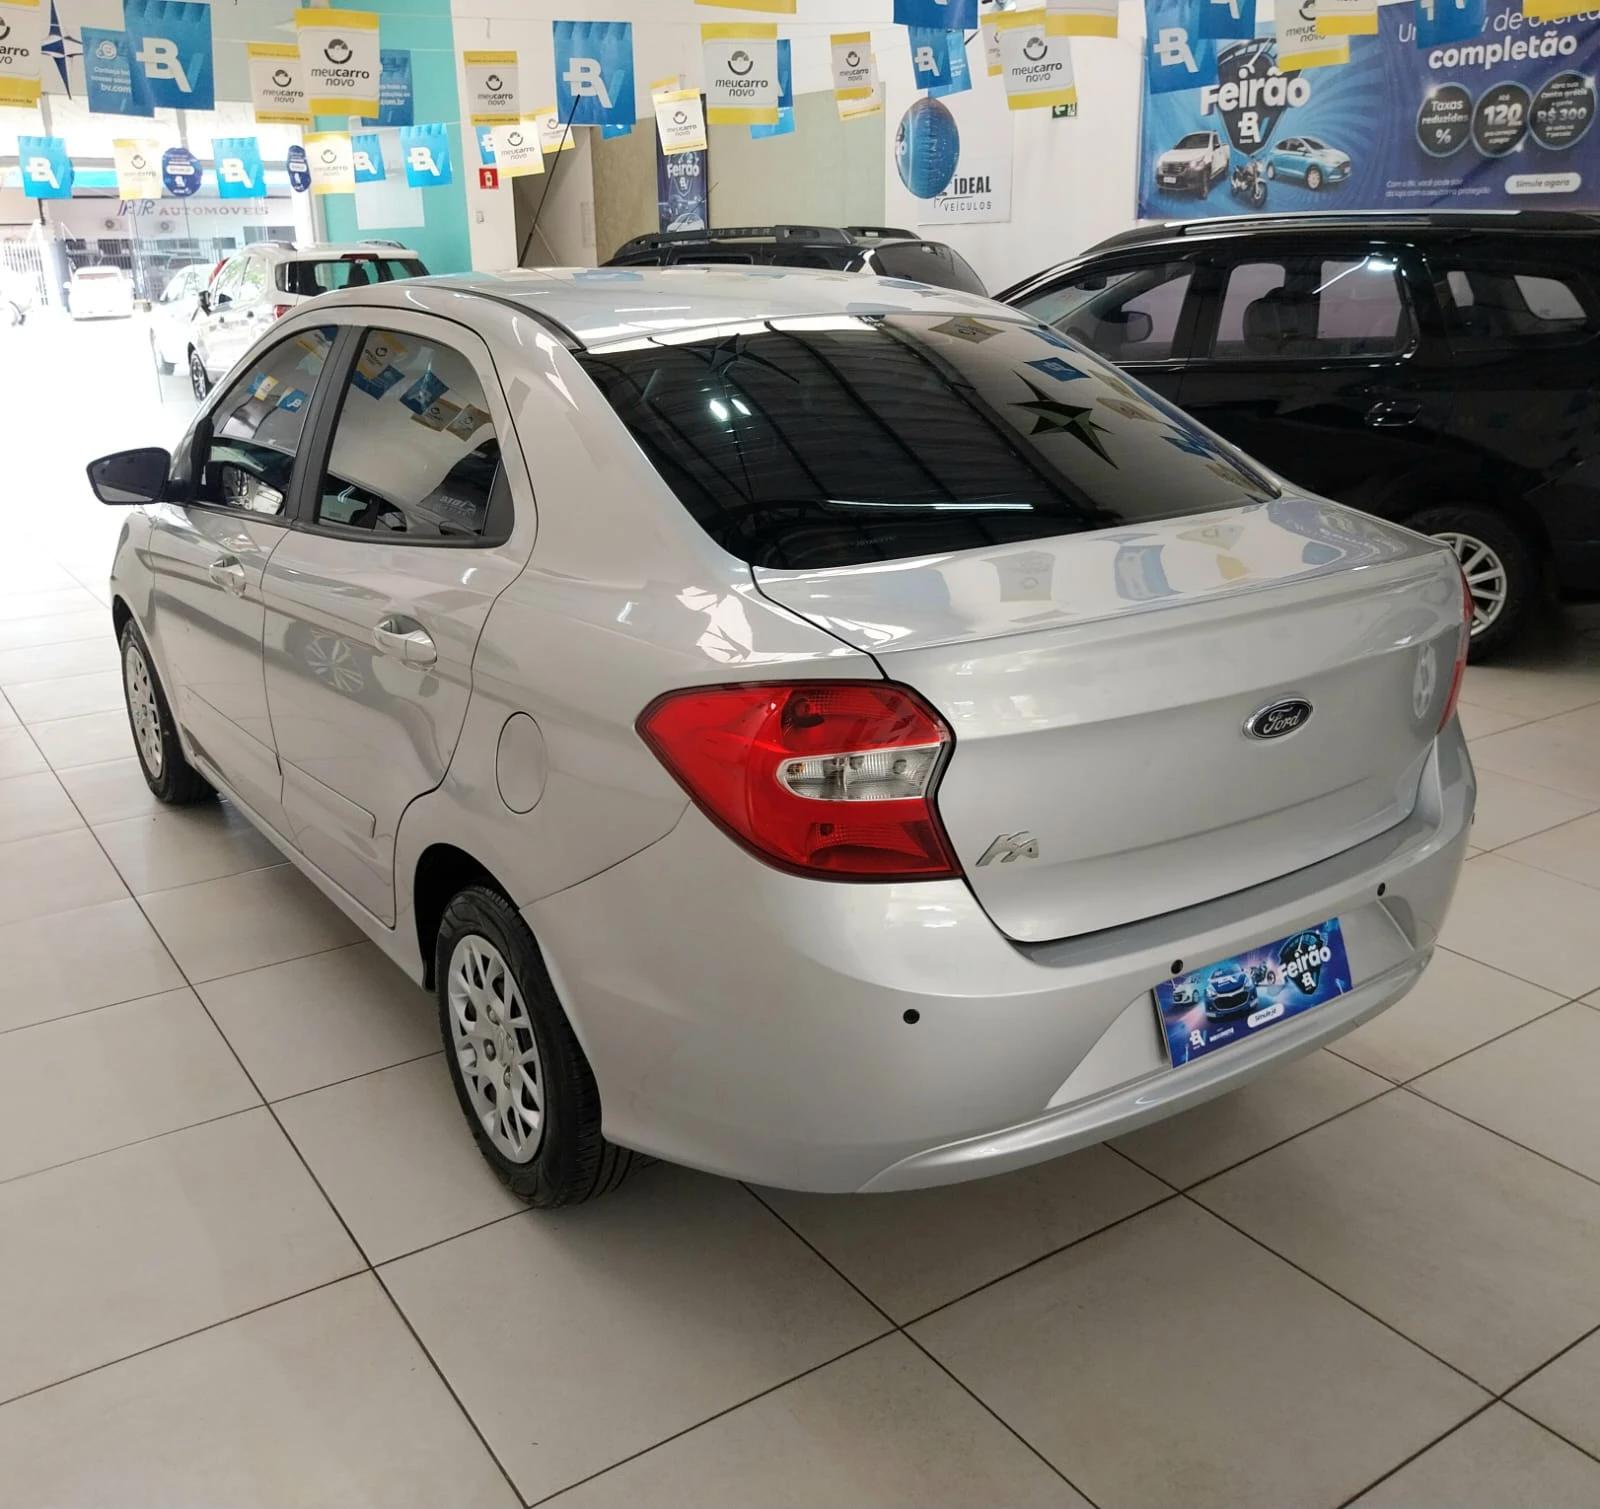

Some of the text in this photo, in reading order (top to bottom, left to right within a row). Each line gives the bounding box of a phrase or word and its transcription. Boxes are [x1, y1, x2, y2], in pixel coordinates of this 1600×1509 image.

[1493, 8, 1523, 32] de
[1286, 25, 1316, 37] meuc
[0, 45, 30, 58] arro
[1428, 31, 1577, 70] completão
[311, 67, 370, 80] meucarro
[840, 68, 869, 77] meucarro
[1012, 61, 1063, 76] meucarro
[325, 77, 355, 88] novo
[715, 77, 769, 89] meucarro
[1025, 72, 1051, 83] novo
[262, 88, 304, 98] meucarro
[728, 87, 755, 97] novo
[1200, 66, 1311, 117] Feirão
[274, 96, 295, 104] novo
[1431, 100, 1464, 112] Taxas
[1483, 103, 1523, 126] 120
[1559, 107, 1587, 121] 300
[667, 160, 700, 179] Feirão
[953, 175, 992, 195] IDEAL
[1262, 705, 1301, 735] Ford
[1278, 945, 1332, 983] Feirão
